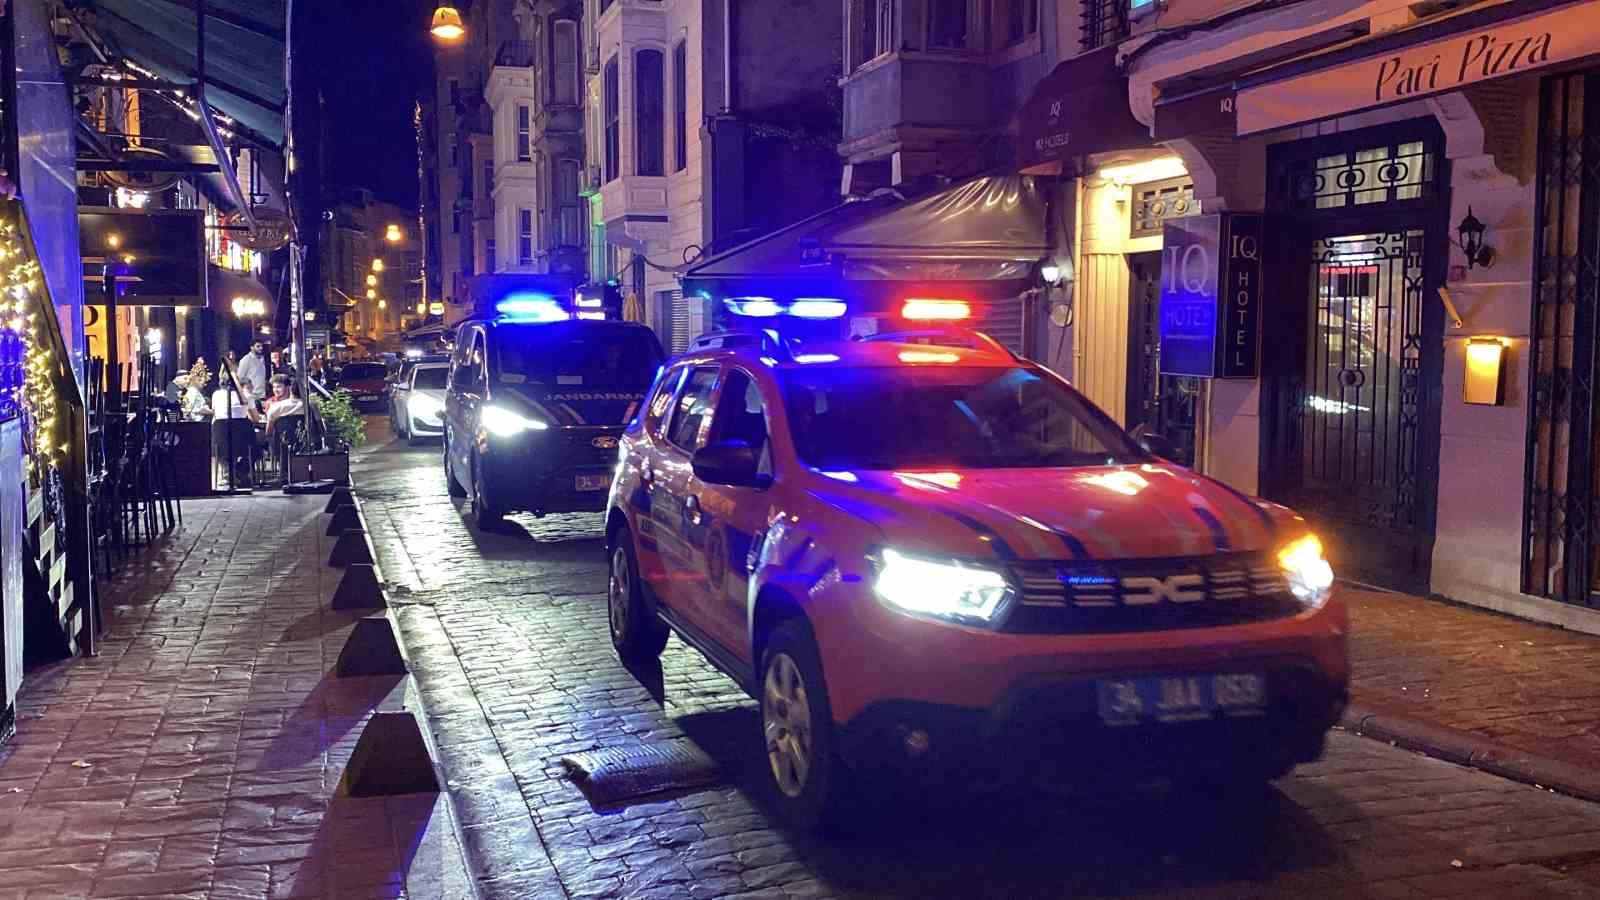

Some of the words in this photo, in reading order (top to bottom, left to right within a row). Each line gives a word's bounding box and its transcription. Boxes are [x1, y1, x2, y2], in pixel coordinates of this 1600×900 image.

[1458, 32, 1551, 82] Pizza
[1220, 97, 1232, 112] IQ
[1167, 244, 1211, 297] IQ
[1231, 235, 1258, 261] IQ
[1235, 271, 1249, 366] HOTEL
